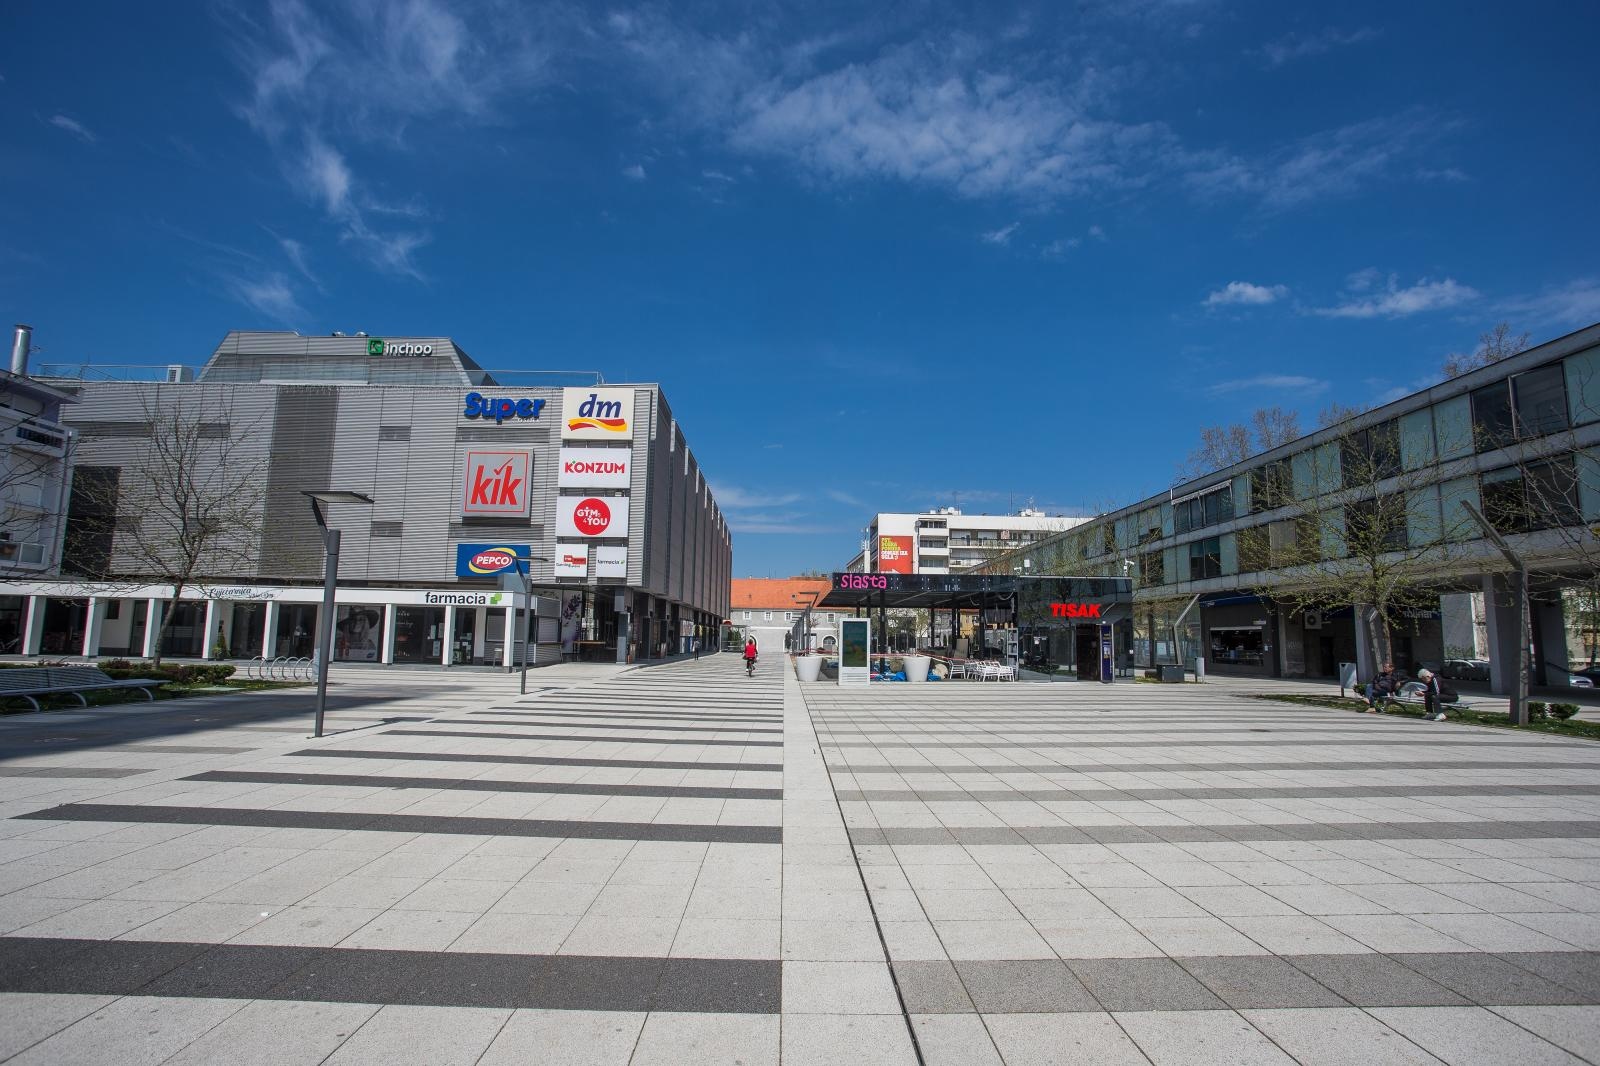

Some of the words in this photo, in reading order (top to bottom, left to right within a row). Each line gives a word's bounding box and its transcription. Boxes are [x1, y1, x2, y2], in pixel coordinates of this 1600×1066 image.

[386, 342, 432, 355] inchoo
[464, 392, 546, 425] Super
[578, 393, 622, 418] dm
[564, 460, 625, 474] KONZUM
[470, 457, 523, 506] kik
[476, 556, 510, 565] PEPCO
[425, 592, 486, 604] farmacia
[1050, 603, 1101, 618] TISAK
